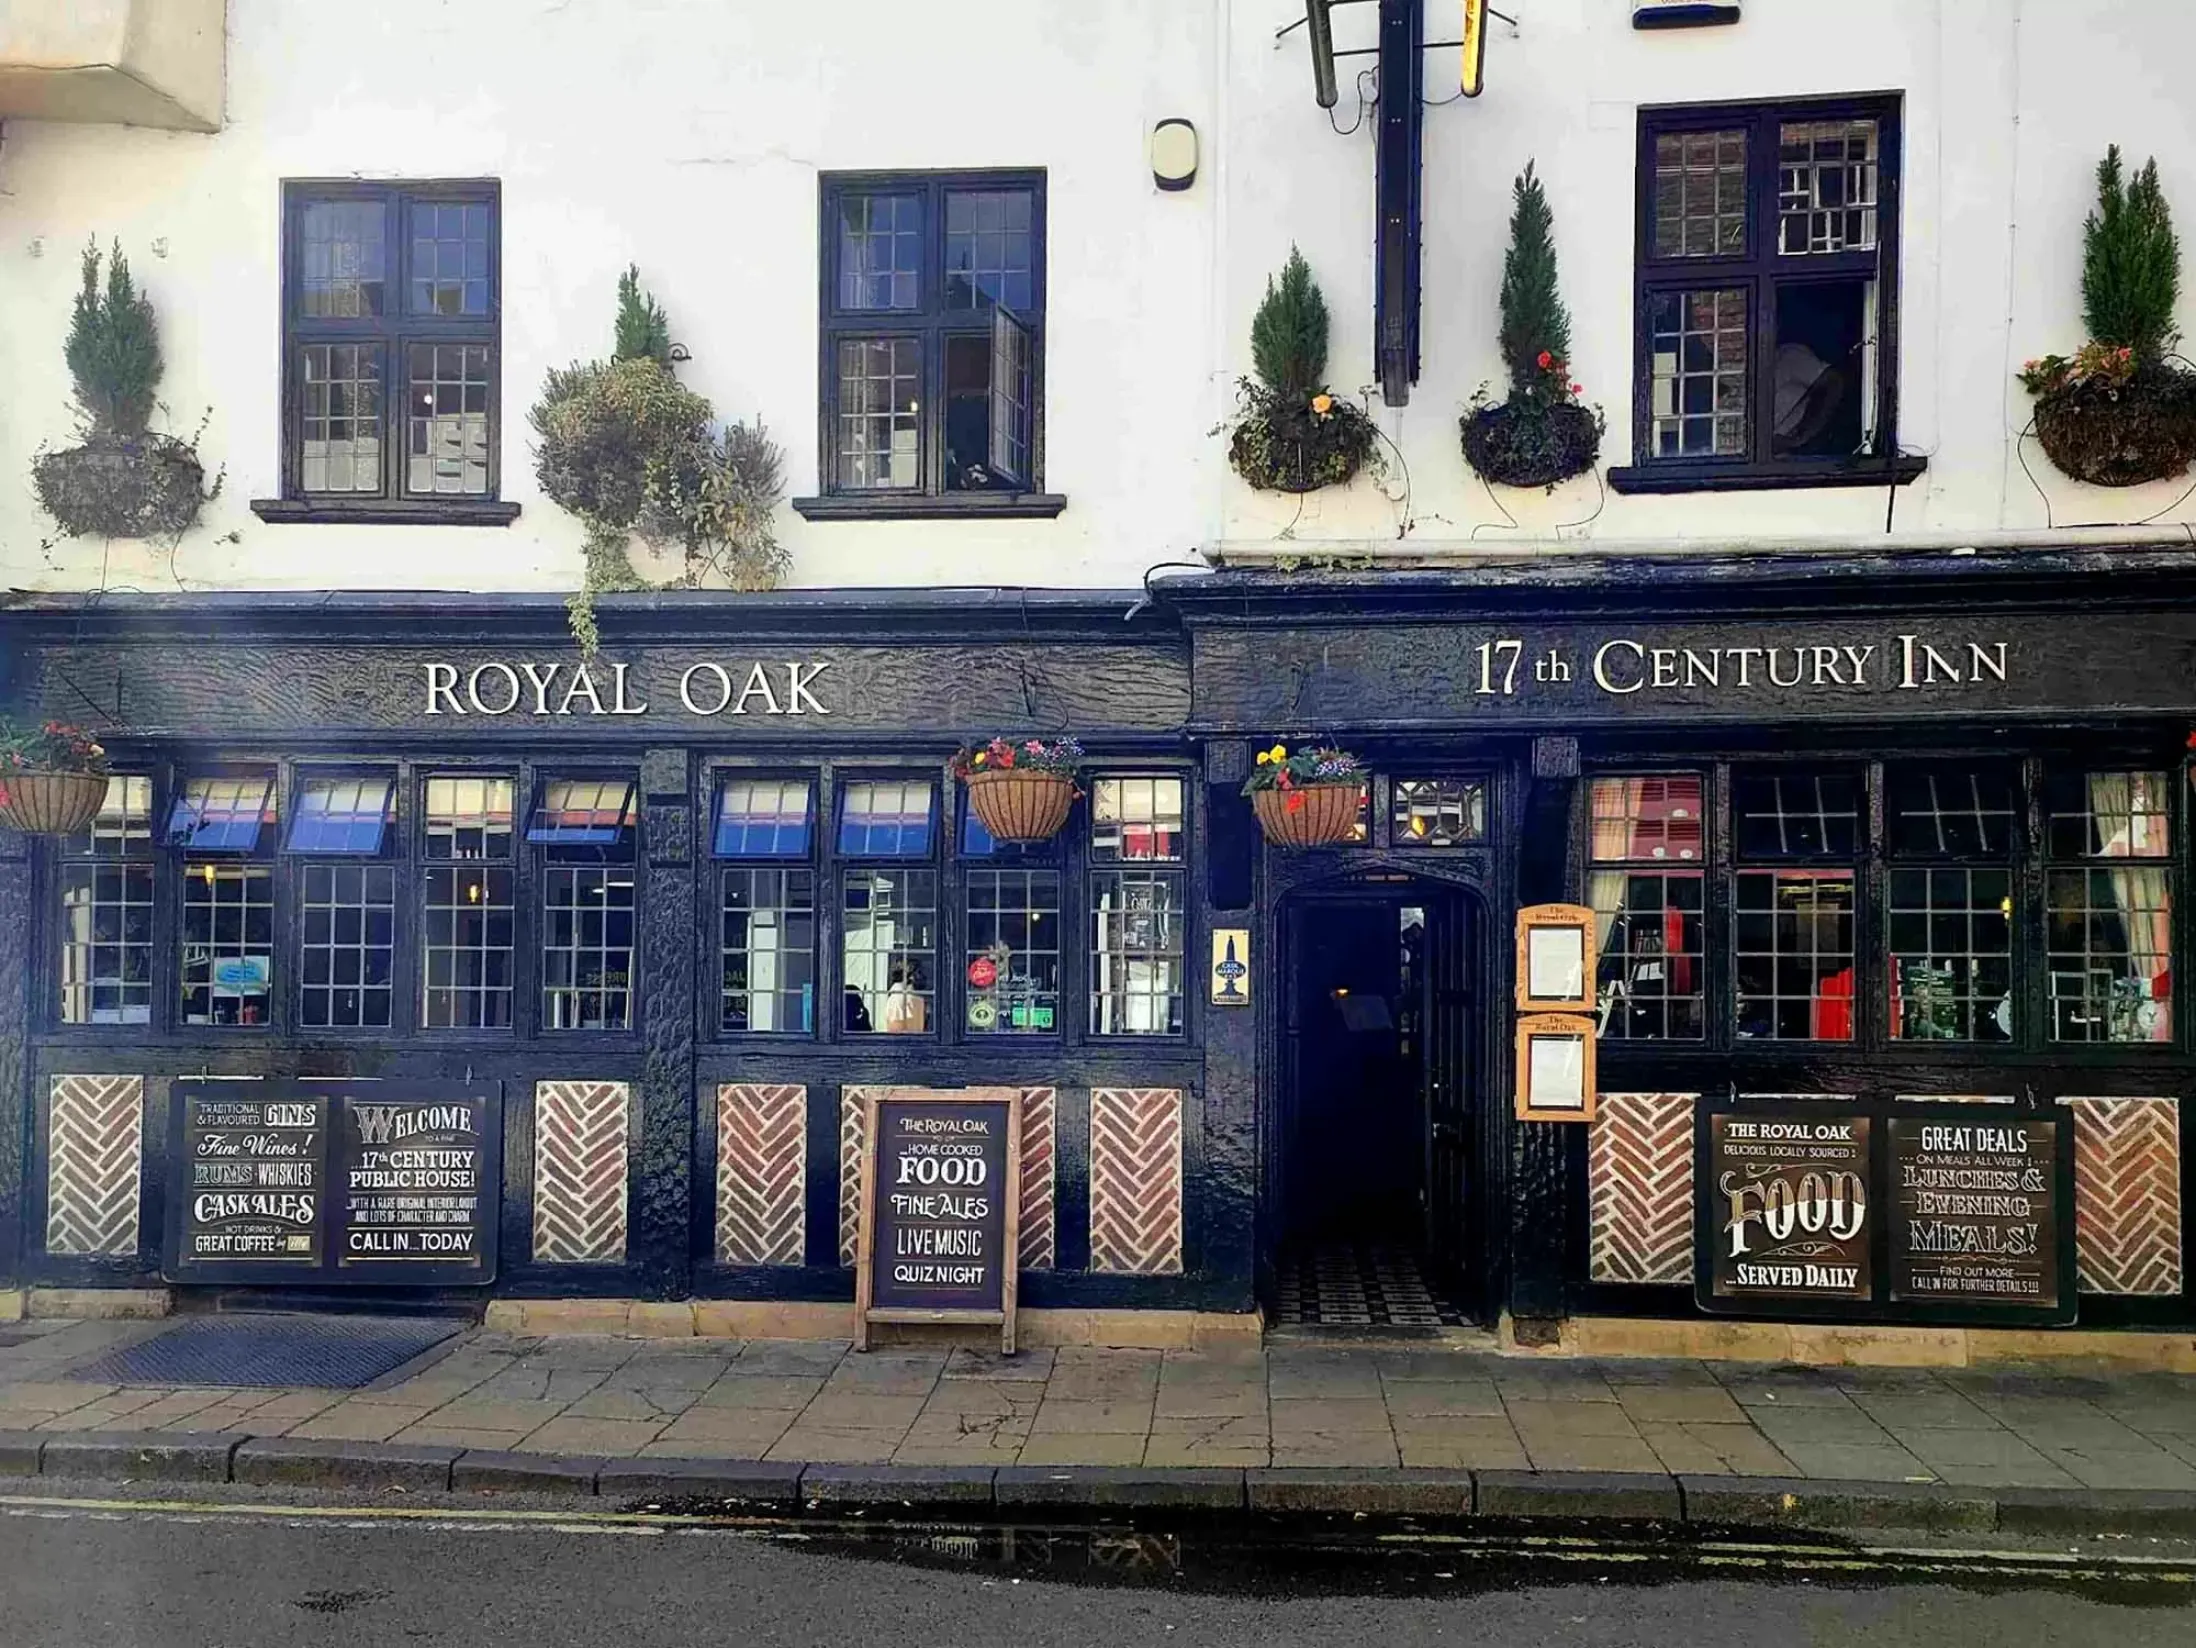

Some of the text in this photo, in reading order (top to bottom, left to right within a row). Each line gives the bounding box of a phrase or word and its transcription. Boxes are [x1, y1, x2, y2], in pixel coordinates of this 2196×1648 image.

[1474, 635, 2008, 695] 17 th CENTURY INN
[424, 662, 830, 716] ROYAL OAK
[201, 1104, 260, 1114] TRADITIONAL
[264, 1104, 316, 1126] GINS
[900, 1118, 989, 1134] THE ROYAL OAK
[1728, 1123, 1852, 1140] THE ROYAL OAK
[197, 1134, 240, 1156] Fine
[940, 1145, 983, 1156] COOKED
[1724, 1144, 1767, 1155] DELICIOUS
[1770, 1146, 1806, 1157] LOCALLY
[1922, 1126, 2027, 1153] GREAT DEALS
[390, 1151, 474, 1168] CENTURY
[1937, 1155, 1970, 1166] MEALS
[1974, 1155, 1992, 1166] ALL
[194, 1163, 312, 1186] RUMS WHISKIES
[350, 1171, 475, 1188] PUBLIC HOUSE!
[896, 1157, 987, 1185] FOOD
[1903, 1165, 2046, 1192] LUNCHES &
[194, 1194, 314, 1223] CASK ALES
[891, 1194, 989, 1220] FINE ALES
[1720, 1171, 1866, 1257] FOOD
[1916, 1191, 2030, 1217] EVENING
[355, 1211, 368, 1222] AND
[370, 1211, 387, 1222] LOTS
[388, 1211, 396, 1222] OF
[397, 1211, 434, 1222] CHARACTER
[435, 1211, 447, 1222] AND
[195, 1236, 234, 1251] GREAT
[234, 1236, 275, 1251] COFFEE
[350, 1233, 392, 1250] CALL
[897, 1229, 982, 1256] LIVE MUSIC
[1909, 1219, 2038, 1255] MEALS!
[894, 1266, 985, 1284] QUIZ NIGHT
[1805, 1264, 1858, 1288] DAILY
[1940, 1265, 2015, 1278] FIND OUT MORE
[1911, 1276, 1931, 1288] CALL
[1943, 1277, 1959, 1290] FOR
[1961, 1278, 1994, 1291] FURTHER
